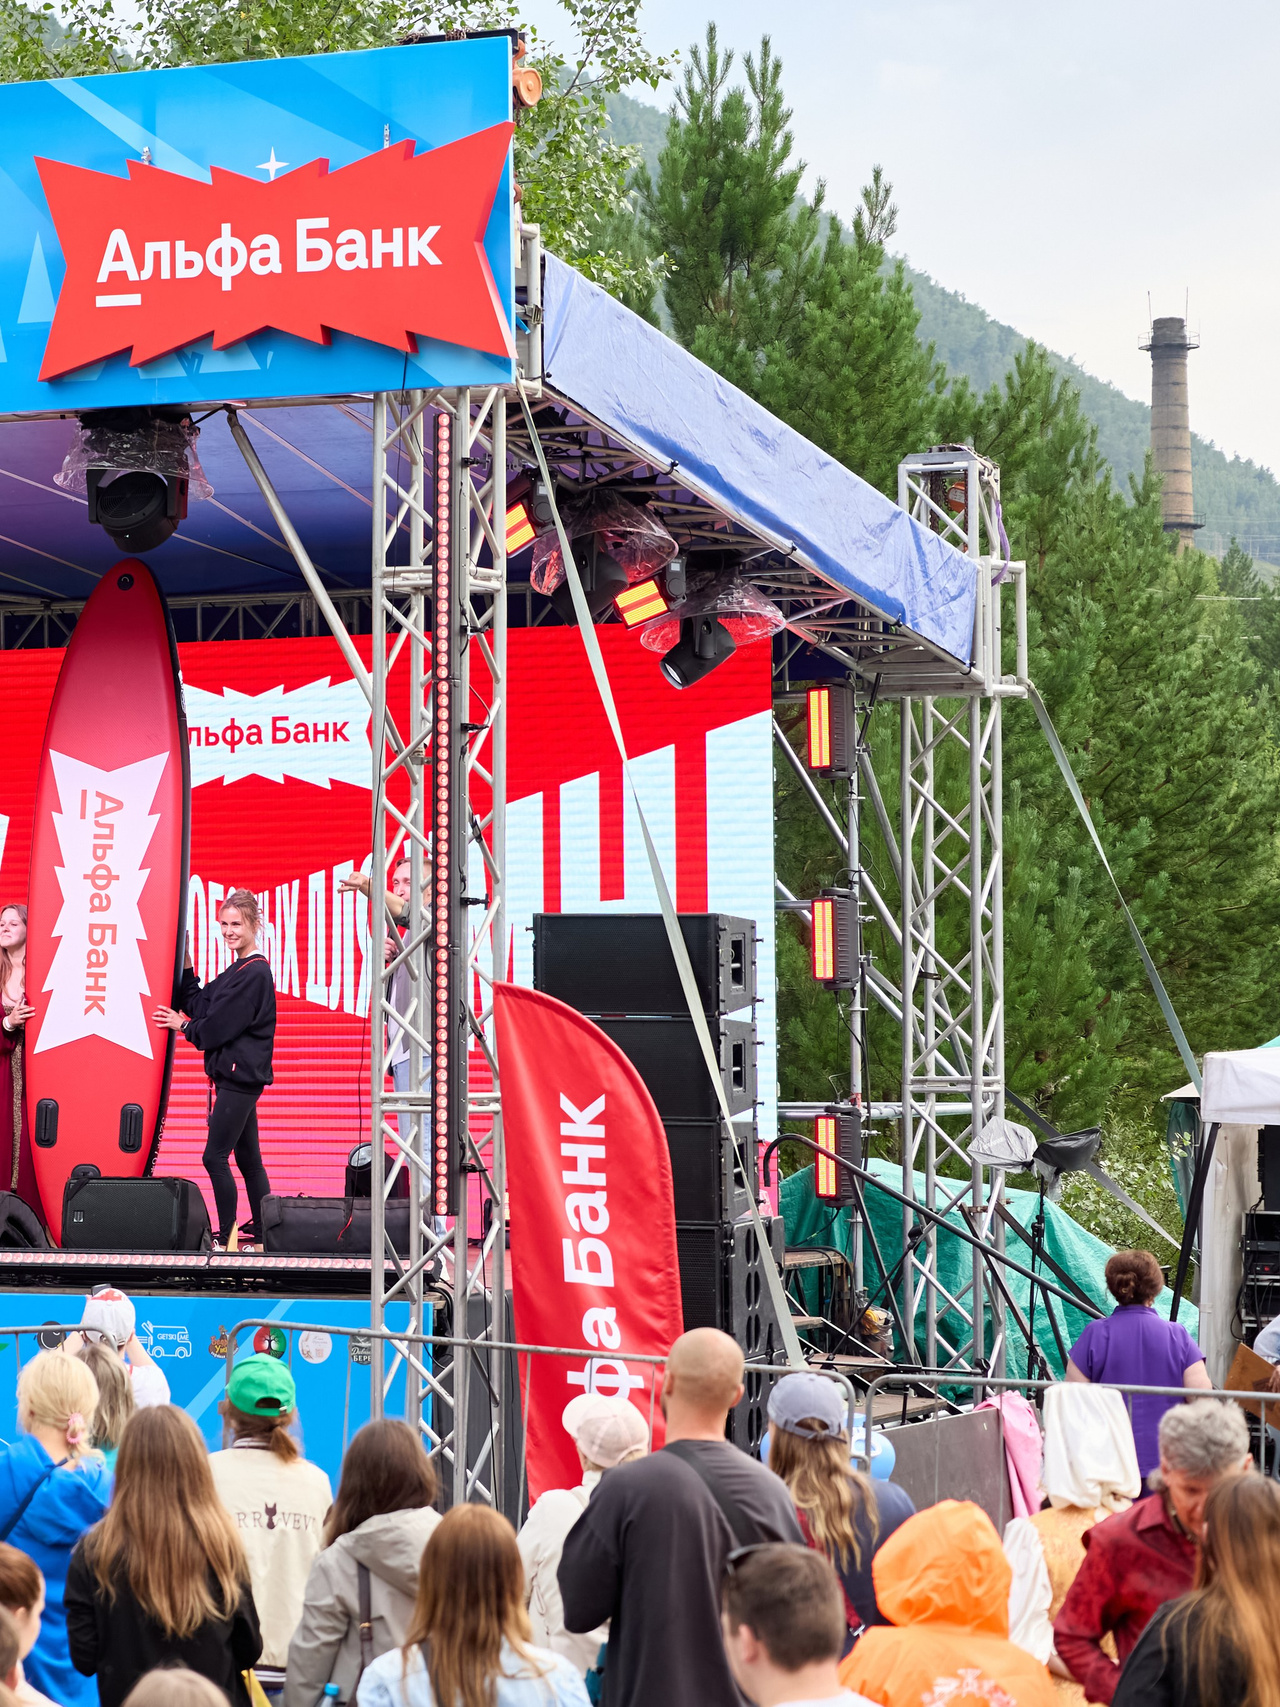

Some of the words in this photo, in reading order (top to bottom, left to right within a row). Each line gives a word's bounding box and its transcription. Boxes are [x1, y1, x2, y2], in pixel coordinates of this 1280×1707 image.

[95, 222, 282, 292] Альфа
[295, 216, 443, 274] Банк
[188, 717, 264, 754] льфа
[271, 715, 351, 745] Банк
[80, 789, 125, 914] Альфа
[83, 922, 118, 1017] Банк
[559, 1091, 615, 1288] Банк
[156, 1333, 177, 1341] GETSKI
[566, 1306, 645, 1400] фа
